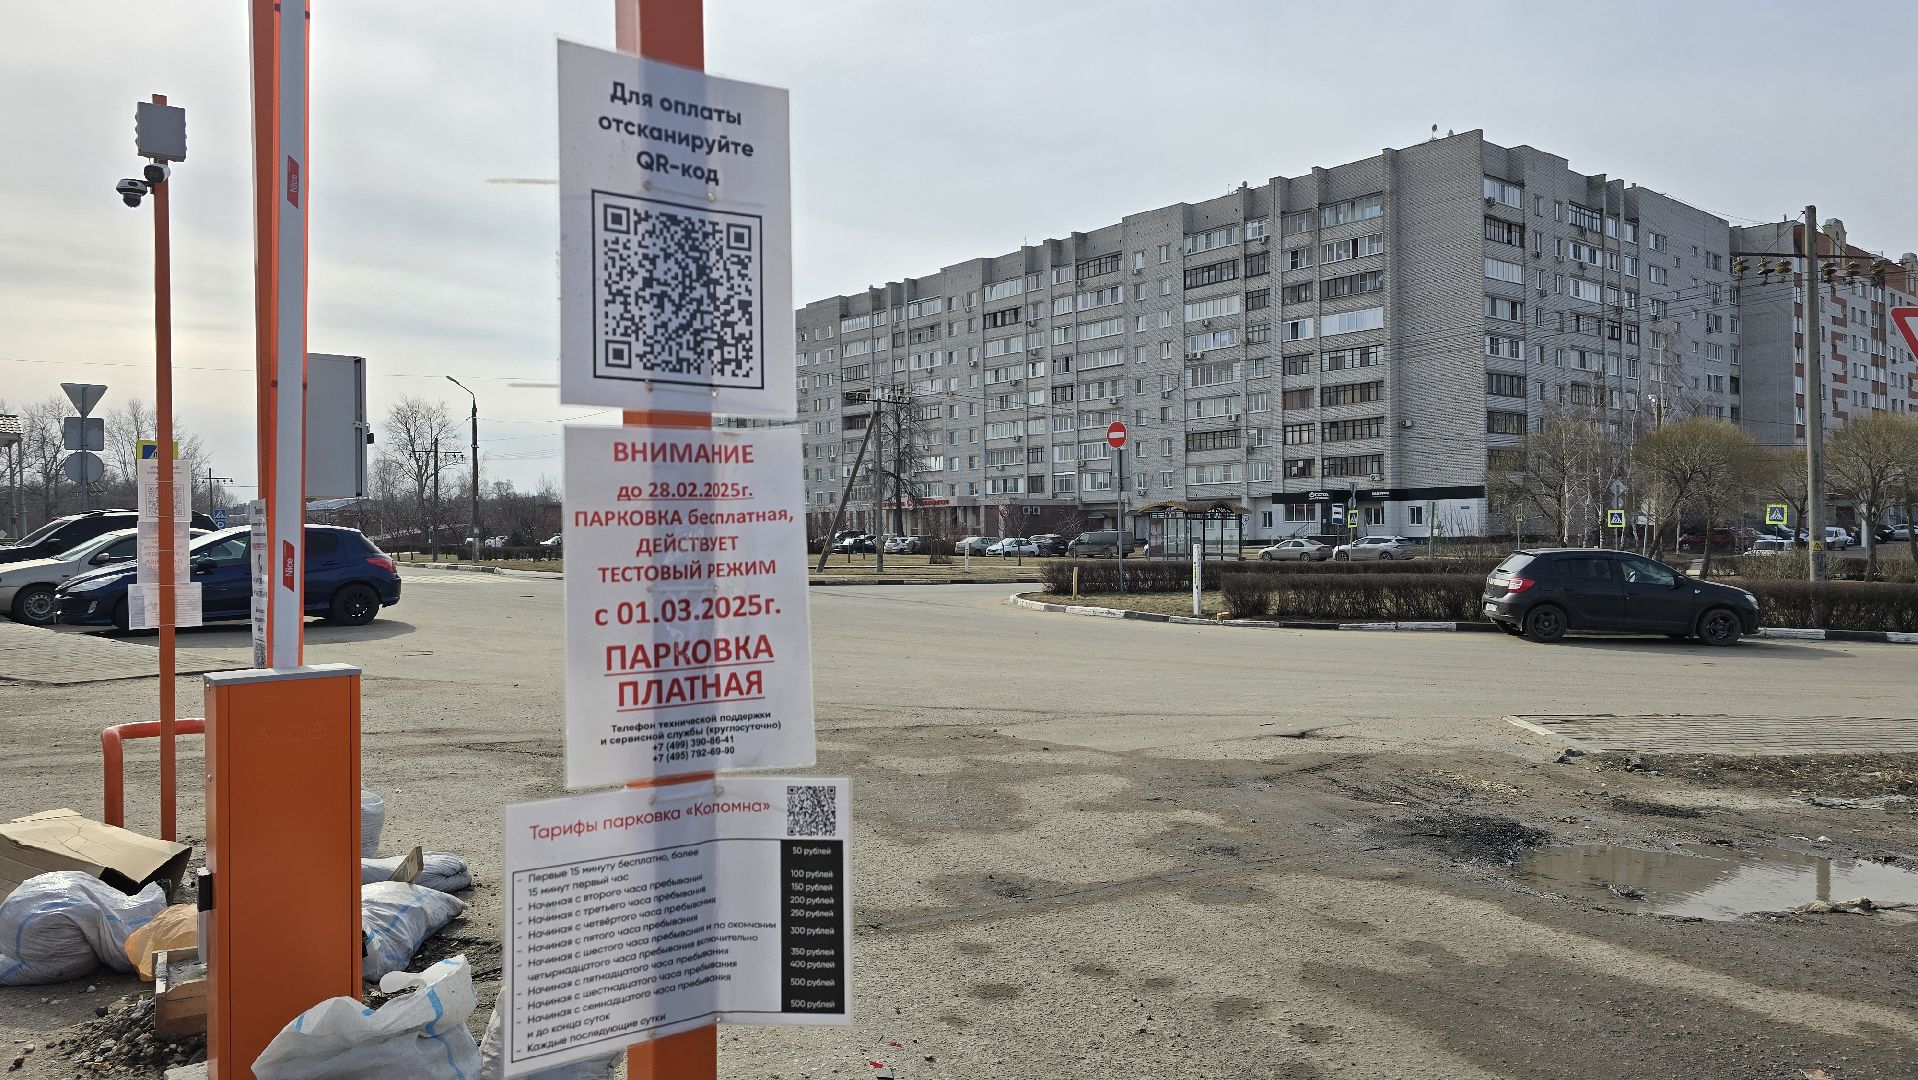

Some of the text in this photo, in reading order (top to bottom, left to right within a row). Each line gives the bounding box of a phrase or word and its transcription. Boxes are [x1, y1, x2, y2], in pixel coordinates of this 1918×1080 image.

[610, 81, 741, 126] Для оплаты
[598, 115, 754, 157] отсканируйте
[636, 150, 720, 186] QR-код
[614, 442, 754, 464] ВНИМАНИЕ
[617, 482, 753, 500] до 28.02.2025г.
[574, 508, 794, 526] ПАРКОВКА бесплатная,
[636, 534, 738, 557] ДЕЙСТВУЕТ
[285, 558, 294, 577] Nice
[598, 560, 776, 583] ТЕСТОВЫЙ РЕЖИМ
[594, 594, 781, 626] с 01.03.2025г.
[606, 634, 774, 671] ПАРКОВКА
[618, 670, 763, 707] ПЛАТНАЯ
[610, 730, 664, 746] сервисной
[667, 726, 703, 741] службы
[706, 721, 782, 736] (круглосуточно)
[611, 712, 771, 733] Телефон технической поддержки
[652, 736, 734, 752] +7 (499) 390-86-41
[666, 750, 688, 763] (495)
[691, 747, 735, 758] 792-69-90
[530, 800, 770, 841] Тарифы парковка «Коломна»
[804, 847, 831, 856] рублей
[528, 849, 699, 882] Первые 15 минуту бесплатно, более
[805, 870, 833, 879] рублей
[528, 888, 538, 897] 15
[540, 884, 570, 894] минут
[572, 876, 609, 889] первый
[528, 897, 572, 911] Начиная
[584, 890, 621, 901] второго
[624, 884, 647, 894] часа
[650, 874, 702, 890] пребывания
[805, 883, 832, 892] рублей
[528, 912, 572, 925] Начиная
[584, 902, 626, 916] третьего
[628, 896, 651, 907] часа
[653, 886, 706, 904] пребывания
[806, 896, 834, 906] рублей
[528, 925, 572, 940] Начиная
[584, 913, 637, 928] четвёртого
[638, 908, 662, 918] часа
[664, 897, 716, 915] пребывания
[806, 909, 834, 918] рублей
[528, 939, 572, 953] Начиная
[584, 931, 615, 943] пятого
[617, 925, 641, 936] часа
[643, 915, 698, 934] пребывания
[806, 927, 834, 936] рублей
[527, 934, 758, 981] четырнадцатого часа пребывания включительно
[528, 953, 572, 968] Начиная
[584, 942, 624, 956] шестого
[626, 937, 649, 948] часа
[651, 926, 704, 945] пребывания
[806, 948, 834, 957] рублей
[528, 981, 572, 996] Начиная
[583, 963, 649, 984] пятнадцатого
[651, 959, 674, 969] часа
[676, 948, 729, 964] пребывания
[807, 960, 835, 970] рублей
[528, 995, 572, 1010] Начиная
[582, 975, 657, 998] шестнадцатого
[660, 970, 681, 980] часа
[684, 961, 737, 976] пребывания
[807, 978, 835, 987] рублей
[527, 1009, 572, 1024] Начиная
[582, 990, 651, 1011] семнадцатого
[654, 984, 676, 995] часа
[678, 974, 731, 991] пребывания
[807, 1000, 835, 1009] рублей
[527, 1014, 666, 1052] Каждые последующие сутки
[535, 1028, 549, 1038] до
[552, 1020, 581, 1033] конца
[584, 1013, 610, 1025] суток
